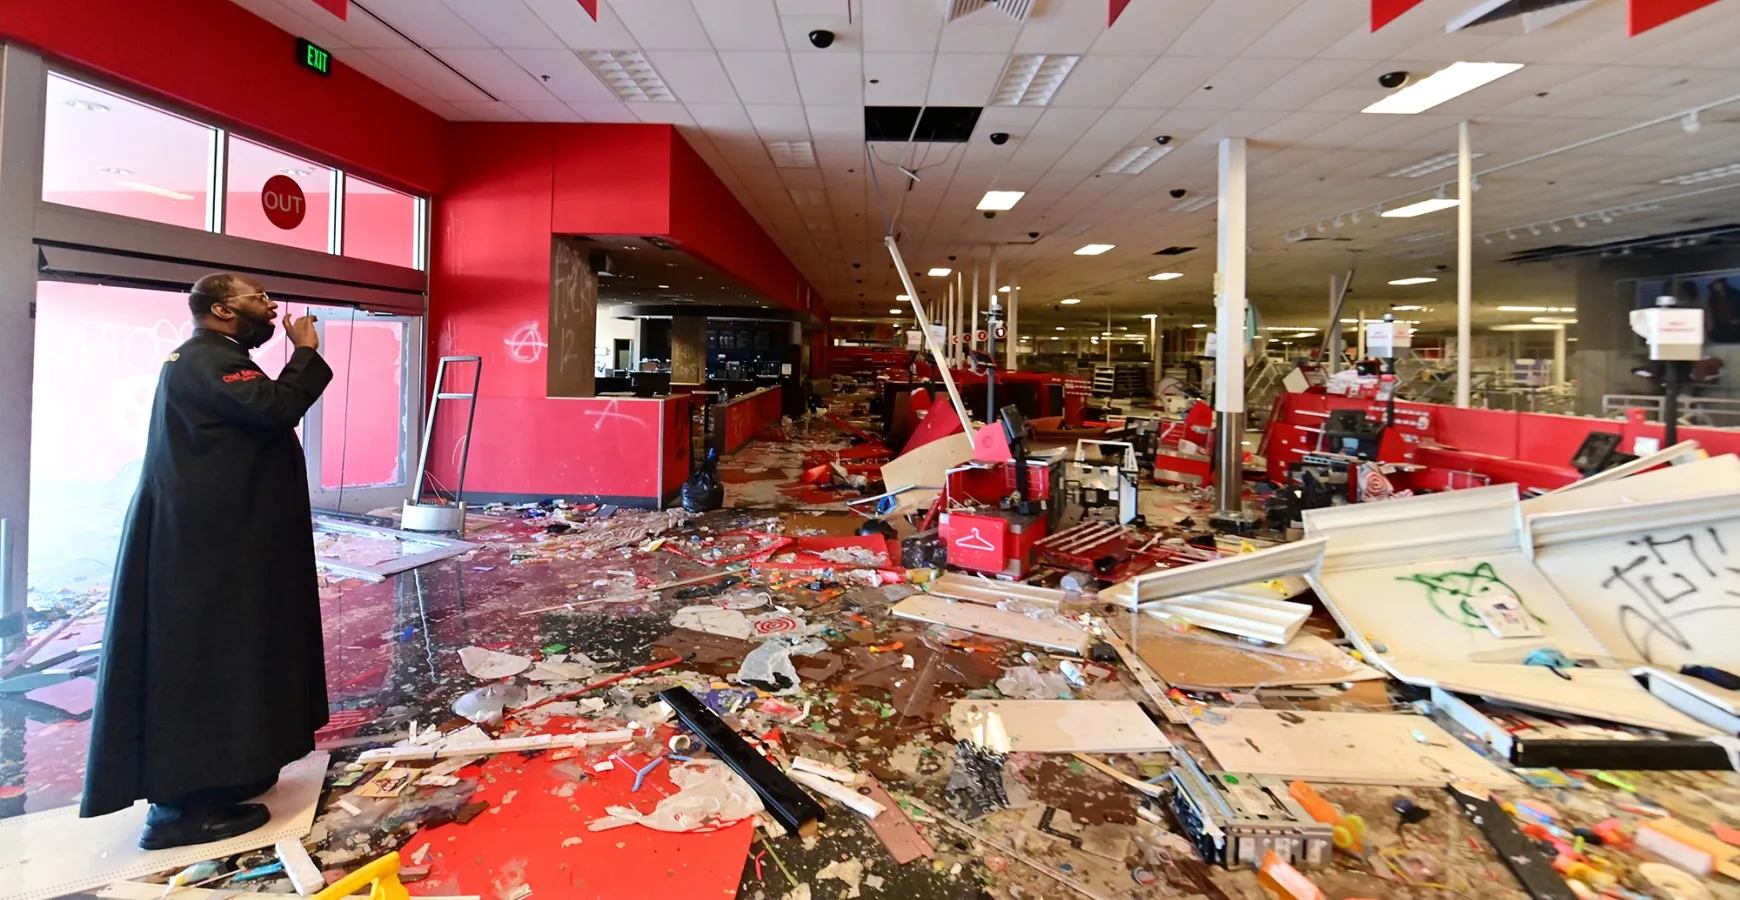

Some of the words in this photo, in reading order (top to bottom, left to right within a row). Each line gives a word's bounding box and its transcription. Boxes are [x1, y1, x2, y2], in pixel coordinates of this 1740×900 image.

[307, 44, 328, 73] EXIT
[264, 190, 303, 214] OUT
[560, 327, 578, 373] 12
